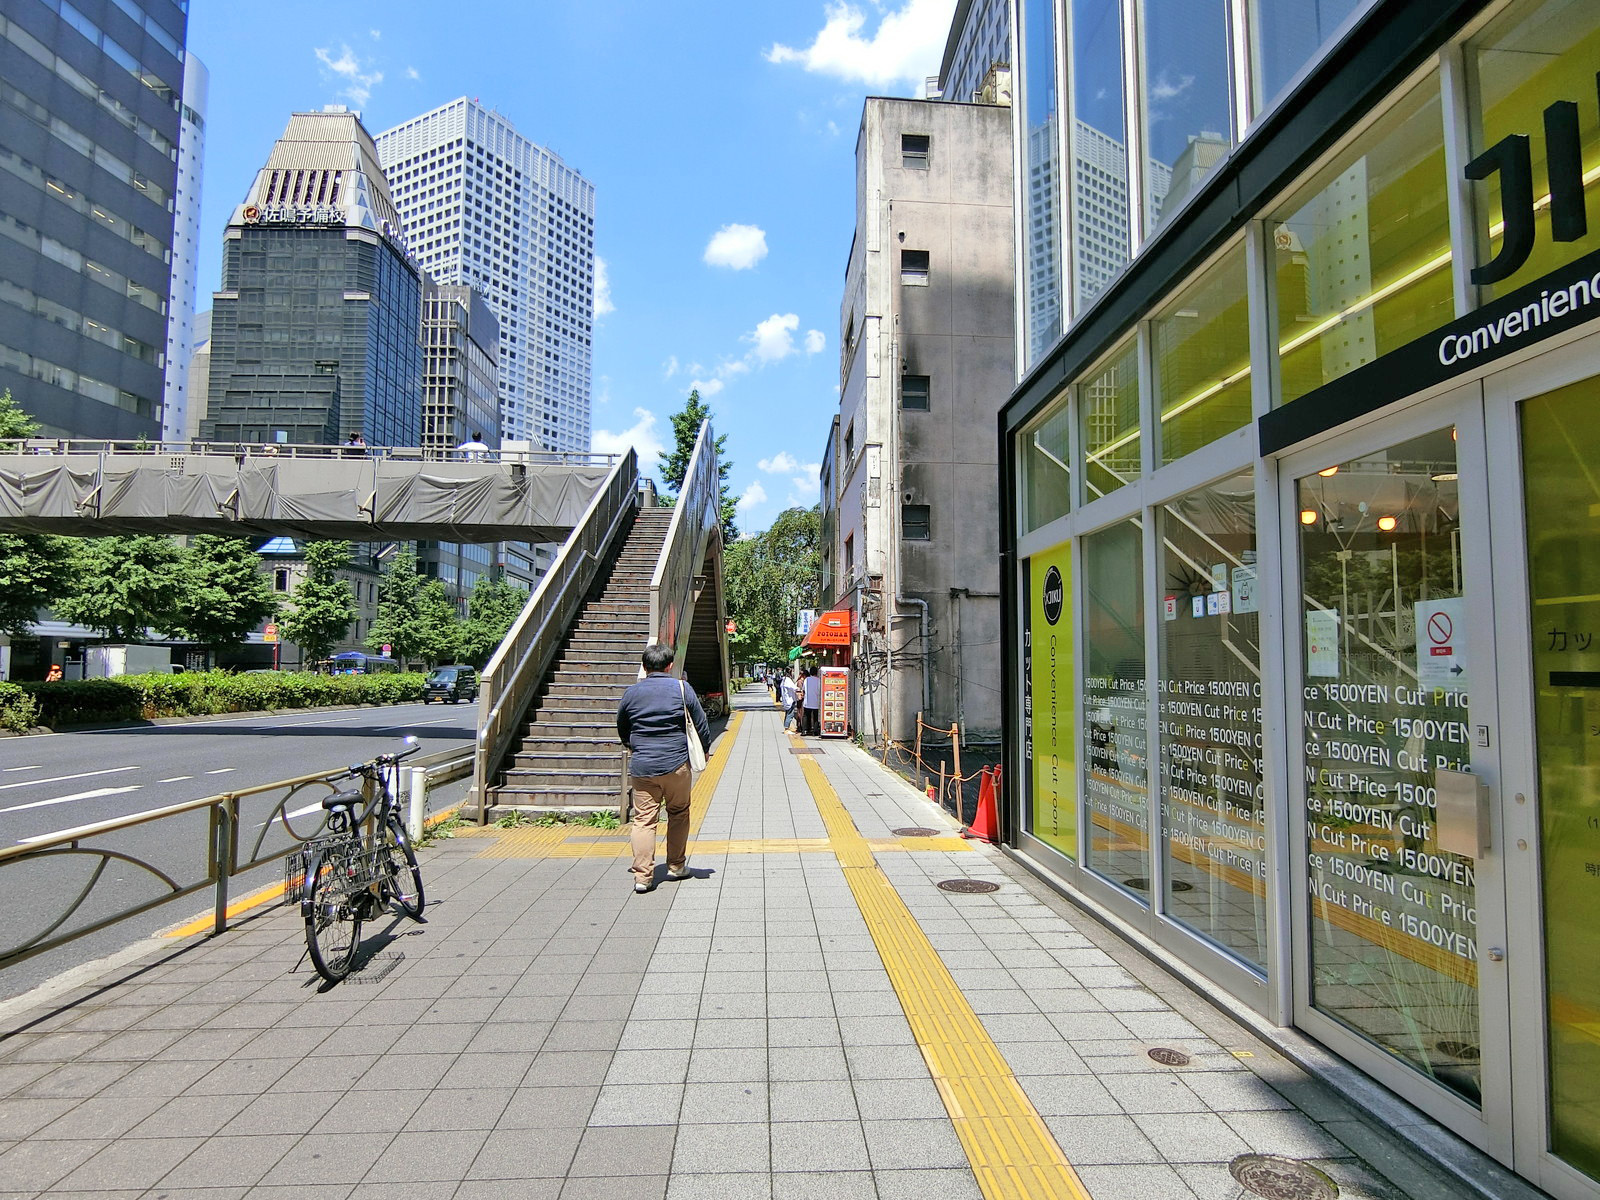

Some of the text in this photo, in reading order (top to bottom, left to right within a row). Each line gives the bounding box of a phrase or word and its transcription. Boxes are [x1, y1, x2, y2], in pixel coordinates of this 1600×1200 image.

[1464, 72, 1600, 285] JI
[264, 207, 345, 223] 佐鳴予備校
[1120, 679, 1134, 690] Price
[1137, 680, 1146, 690] 15
[1168, 680, 1182, 694] Cut
[1185, 680, 1205, 695] Price
[1208, 681, 1250, 697] 1500YEN
[1304, 683, 1468, 709] ce 1500YEN Cut Pric
[1168, 701, 1201, 717] 1500YEN
[1204, 704, 1220, 719] Cut
[1223, 705, 1247, 721] Price
[1093, 729, 1106, 741] Price
[1169, 722, 1183, 736] Cut
[1186, 724, 1206, 740] Price
[1209, 727, 1251, 747] 1500YEN
[1318, 712, 1341, 730] Cut
[1348, 714, 1385, 735] Price
[1392, 717, 1470, 743] 1500YEN
[1169, 743, 1202, 762] 1500YEN
[1205, 750, 1221, 765] Cut
[1225, 753, 1249, 771] Price
[1305, 742, 1320, 755] ce
[1326, 741, 1390, 767] 1500YEN
[1397, 750, 1428, 773] Cut
[1094, 764, 1107, 777] Price
[1135, 776, 1146, 789] Cut
[1171, 764, 1184, 779] Cut
[1187, 768, 1207, 785] Price
[1210, 774, 1252, 797] 1500YEN
[1320, 769, 1343, 788] Cut
[1350, 774, 1386, 797] Price
[1109, 804, 1134, 823] 1500YEN
[1169, 785, 1204, 807] 1500YEN
[1207, 796, 1222, 813] Cut
[1226, 801, 1250, 821] Price
[1171, 807, 1185, 823] Cut
[1188, 812, 1207, 831] Price
[1211, 820, 1254, 850] 1500YEN
[1307, 797, 1430, 840] ce 1500YEN Cut
[1170, 828, 1205, 853] 1500YEN
[1208, 842, 1223, 860] Cut
[1227, 850, 1251, 871] Price
[1321, 826, 1345, 848] Cut
[1351, 834, 1389, 861] Price
[1397, 847, 1475, 887] 1500YEN
[1309, 854, 1476, 925] ce 1500YEN Cut Pric
[1323, 883, 1347, 908] Cut
[1353, 893, 1391, 925] Price
[1399, 912, 1477, 960] 1500YEN
